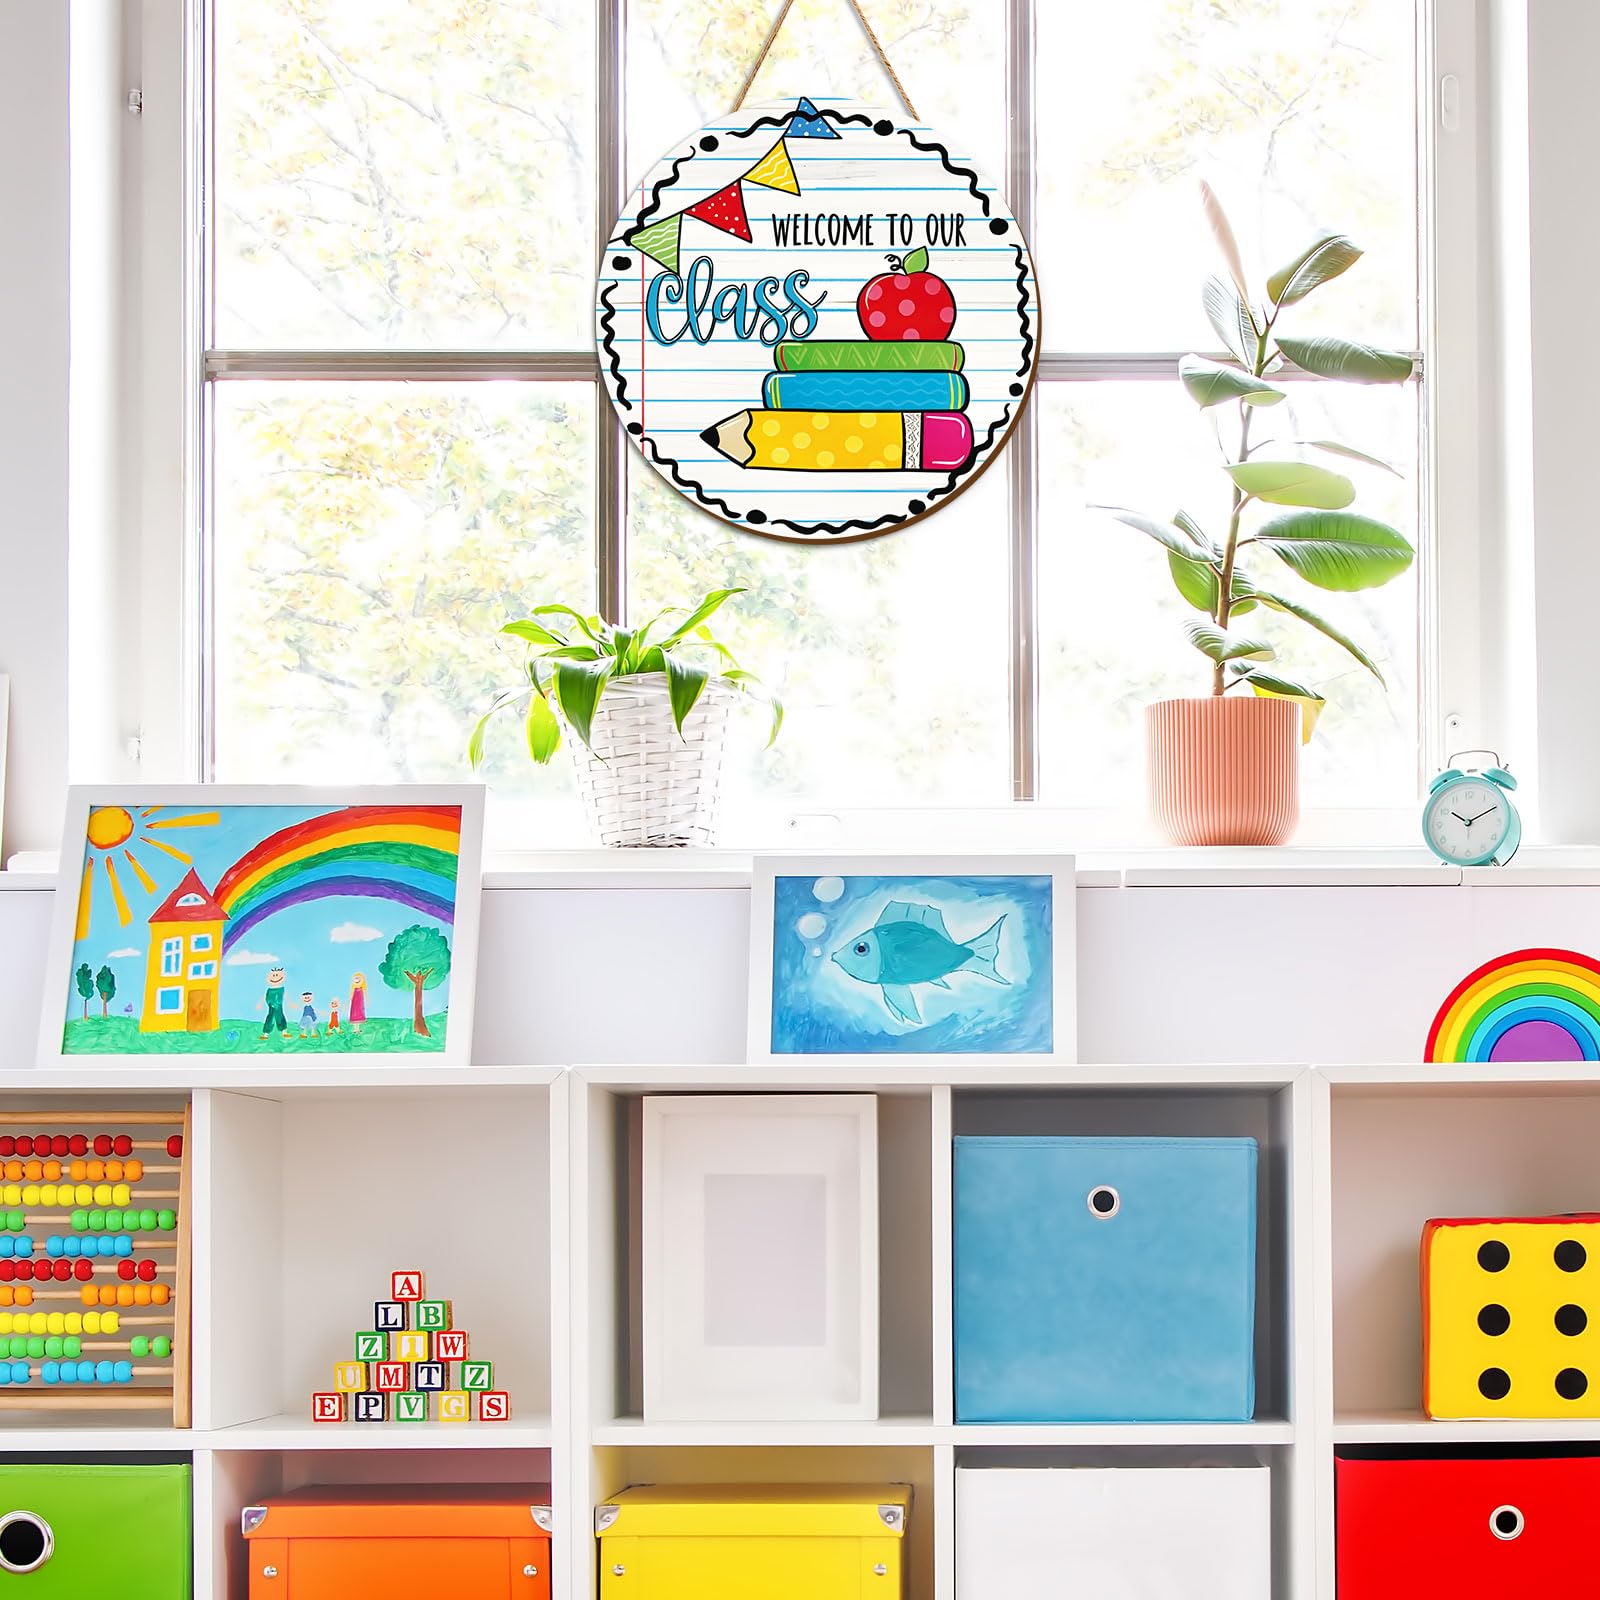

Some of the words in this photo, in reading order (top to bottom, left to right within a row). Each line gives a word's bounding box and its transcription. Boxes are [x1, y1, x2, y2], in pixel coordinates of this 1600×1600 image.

[772, 213, 874, 247] WELCOME
[886, 213, 913, 246] TO
[925, 213, 967, 247] OUR
[645, 256, 828, 346] Class
[396, 1276, 417, 1296] A
[381, 1307, 398, 1326] L
[423, 1306, 441, 1325] B
[362, 1337, 378, 1357] Z
[441, 1336, 461, 1356] W
[338, 1367, 358, 1388] U
[381, 1367, 401, 1387] M
[420, 1366, 439, 1385] T
[469, 1367, 485, 1387] Z
[318, 1397, 336, 1417] E
[362, 1397, 380, 1417] P
[403, 1397, 421, 1416] V
[444, 1397, 463, 1416] G
[486, 1397, 502, 1417] S
